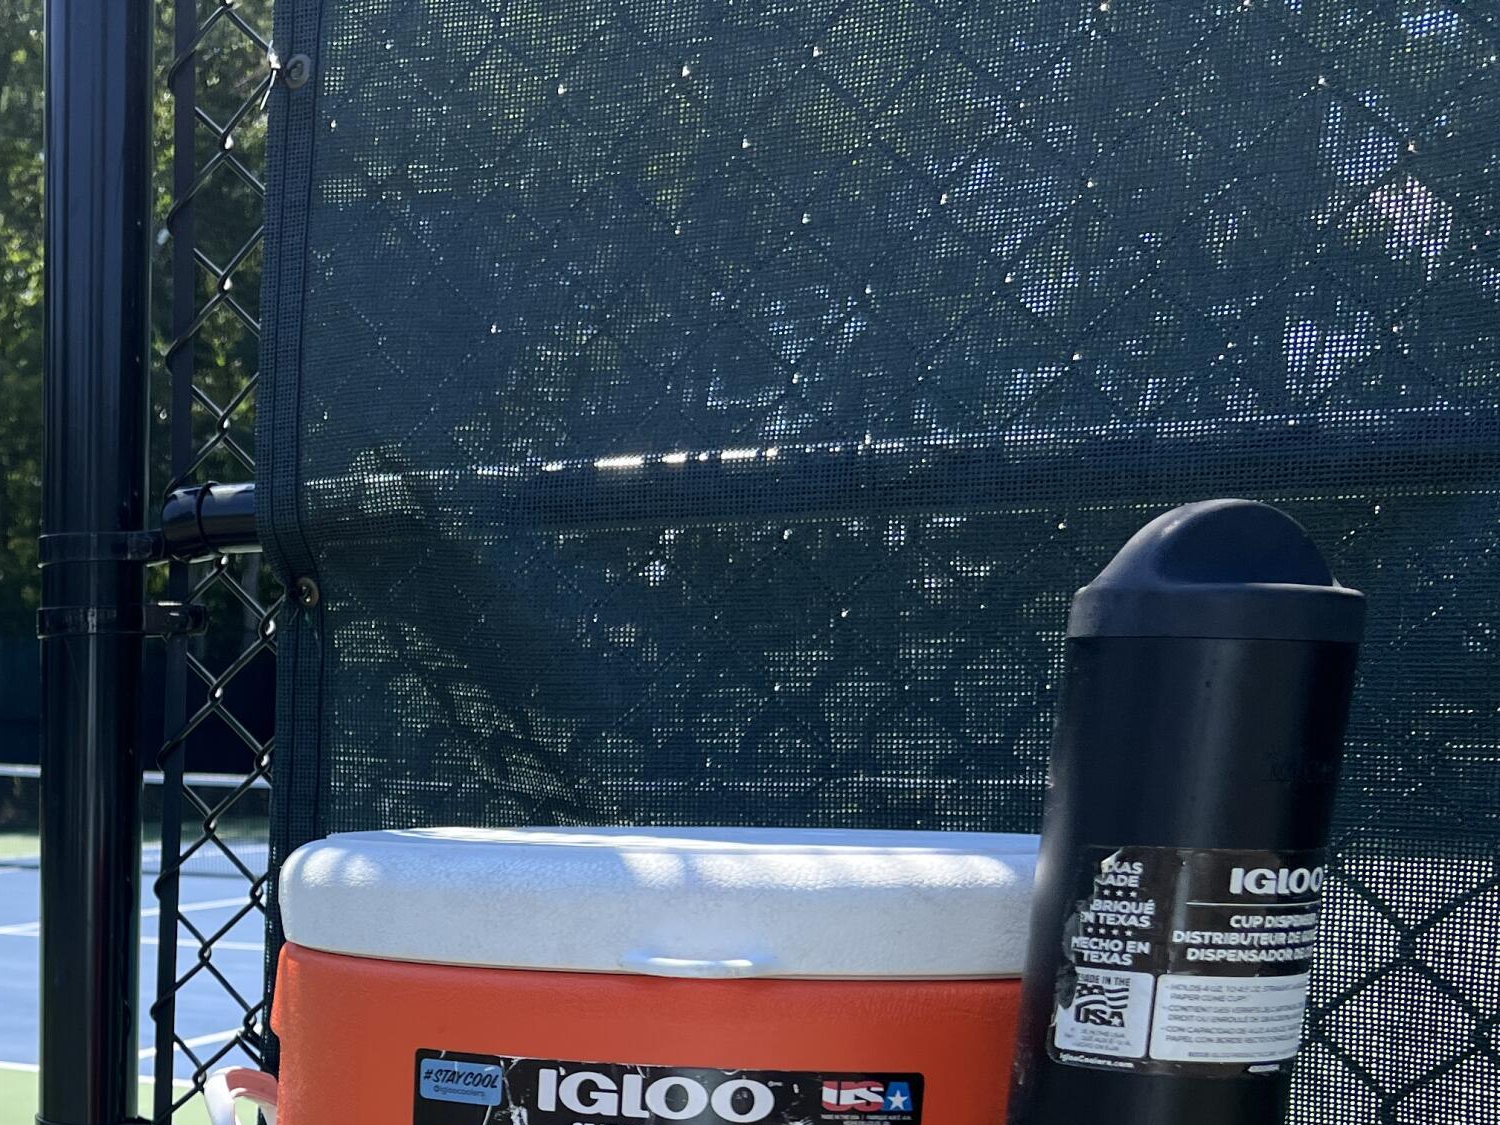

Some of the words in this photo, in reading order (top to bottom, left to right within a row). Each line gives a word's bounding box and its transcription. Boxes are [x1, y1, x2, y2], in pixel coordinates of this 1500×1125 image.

[1100, 874, 1140, 888] ADE
[1229, 867, 1323, 894] IGLOO
[1092, 899, 1156, 915] BRIQUÉ
[1097, 913, 1151, 928] TEXAS
[1230, 915, 1263, 928] CUP
[1071, 936, 1123, 951] HECHO
[1126, 941, 1151, 954] EN
[1172, 931, 1286, 946] DISTRIBUTEUR
[1083, 951, 1132, 965] TEXAS
[1186, 948, 1293, 962] DISPENSADOR
[423, 1069, 500, 1089] #STAYCOOL
[538, 1068, 775, 1123] IGLOO
[821, 1080, 913, 1112] USA
